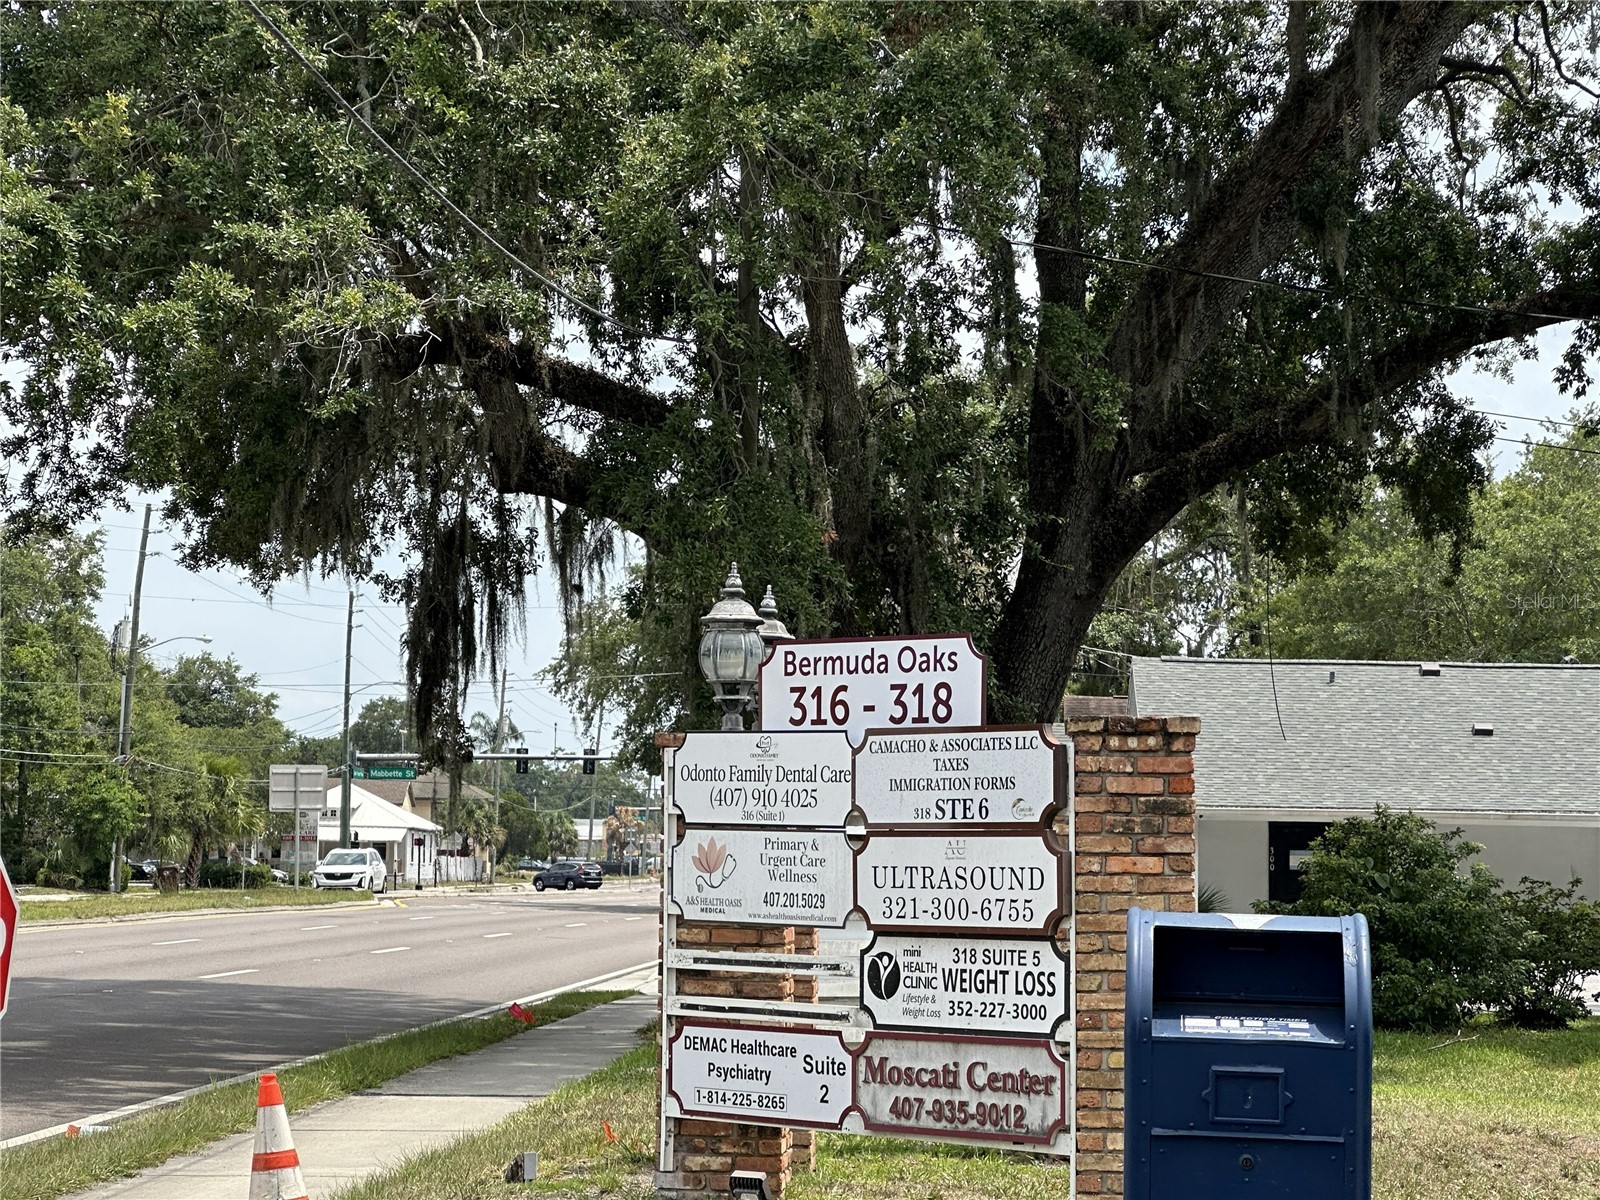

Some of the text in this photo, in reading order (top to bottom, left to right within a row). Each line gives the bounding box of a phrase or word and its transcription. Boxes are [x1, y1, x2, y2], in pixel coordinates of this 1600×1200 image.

[783, 645, 958, 677] Bermuda Oaks
[788, 682, 953, 726] 316 - 318
[869, 736, 1039, 754] CAMACHO & ASSOCIATES LLC
[370, 769, 403, 778] Mabbette
[405, 770, 415, 778] St
[933, 757, 969, 771] TAXES
[681, 764, 851, 787] Odonto Family Dental Care
[889, 776, 1016, 791] IMMIGRATION FORMS
[710, 786, 818, 810] (407) 910 4025
[741, 810, 785, 822] 316 (Suite 1)
[914, 808, 931, 819] 318
[934, 798, 974, 820] STE
[978, 797, 989, 820] 6
[764, 837, 819, 854] Primary &
[760, 853, 826, 869] Urgent Care
[768, 869, 817, 883] Wellness
[872, 866, 1045, 890] ULTRASOUND
[685, 896, 742, 907] A&S HEALTH OASIS
[763, 892, 825, 909] 407.201.5029
[882, 896, 1034, 922] 321-300-6755
[748, 912, 837, 923] www.ashealthoasismedical.com
[903, 945, 921, 957] mini
[952, 948, 1041, 967] 318 SUITE 5
[903, 962, 937, 974] HEALTH
[903, 976, 938, 990] CLINIC
[942, 968, 1056, 997] WEIGHT LOSS
[902, 994, 936, 1004] Lifestyle &
[902, 1007, 941, 1019] Weight Loss
[948, 1000, 1047, 1021] 352-227-3000
[684, 1035, 797, 1058] DEMAC Healthcare
[708, 1062, 771, 1086] Psychiatry
[803, 1054, 847, 1076] Suite
[862, 1055, 1057, 1096] Moscati Center
[696, 1090, 785, 1110] 1-814-225-8265
[819, 1084, 829, 1104] 2
[889, 1095, 1027, 1129] 407-935-9012
